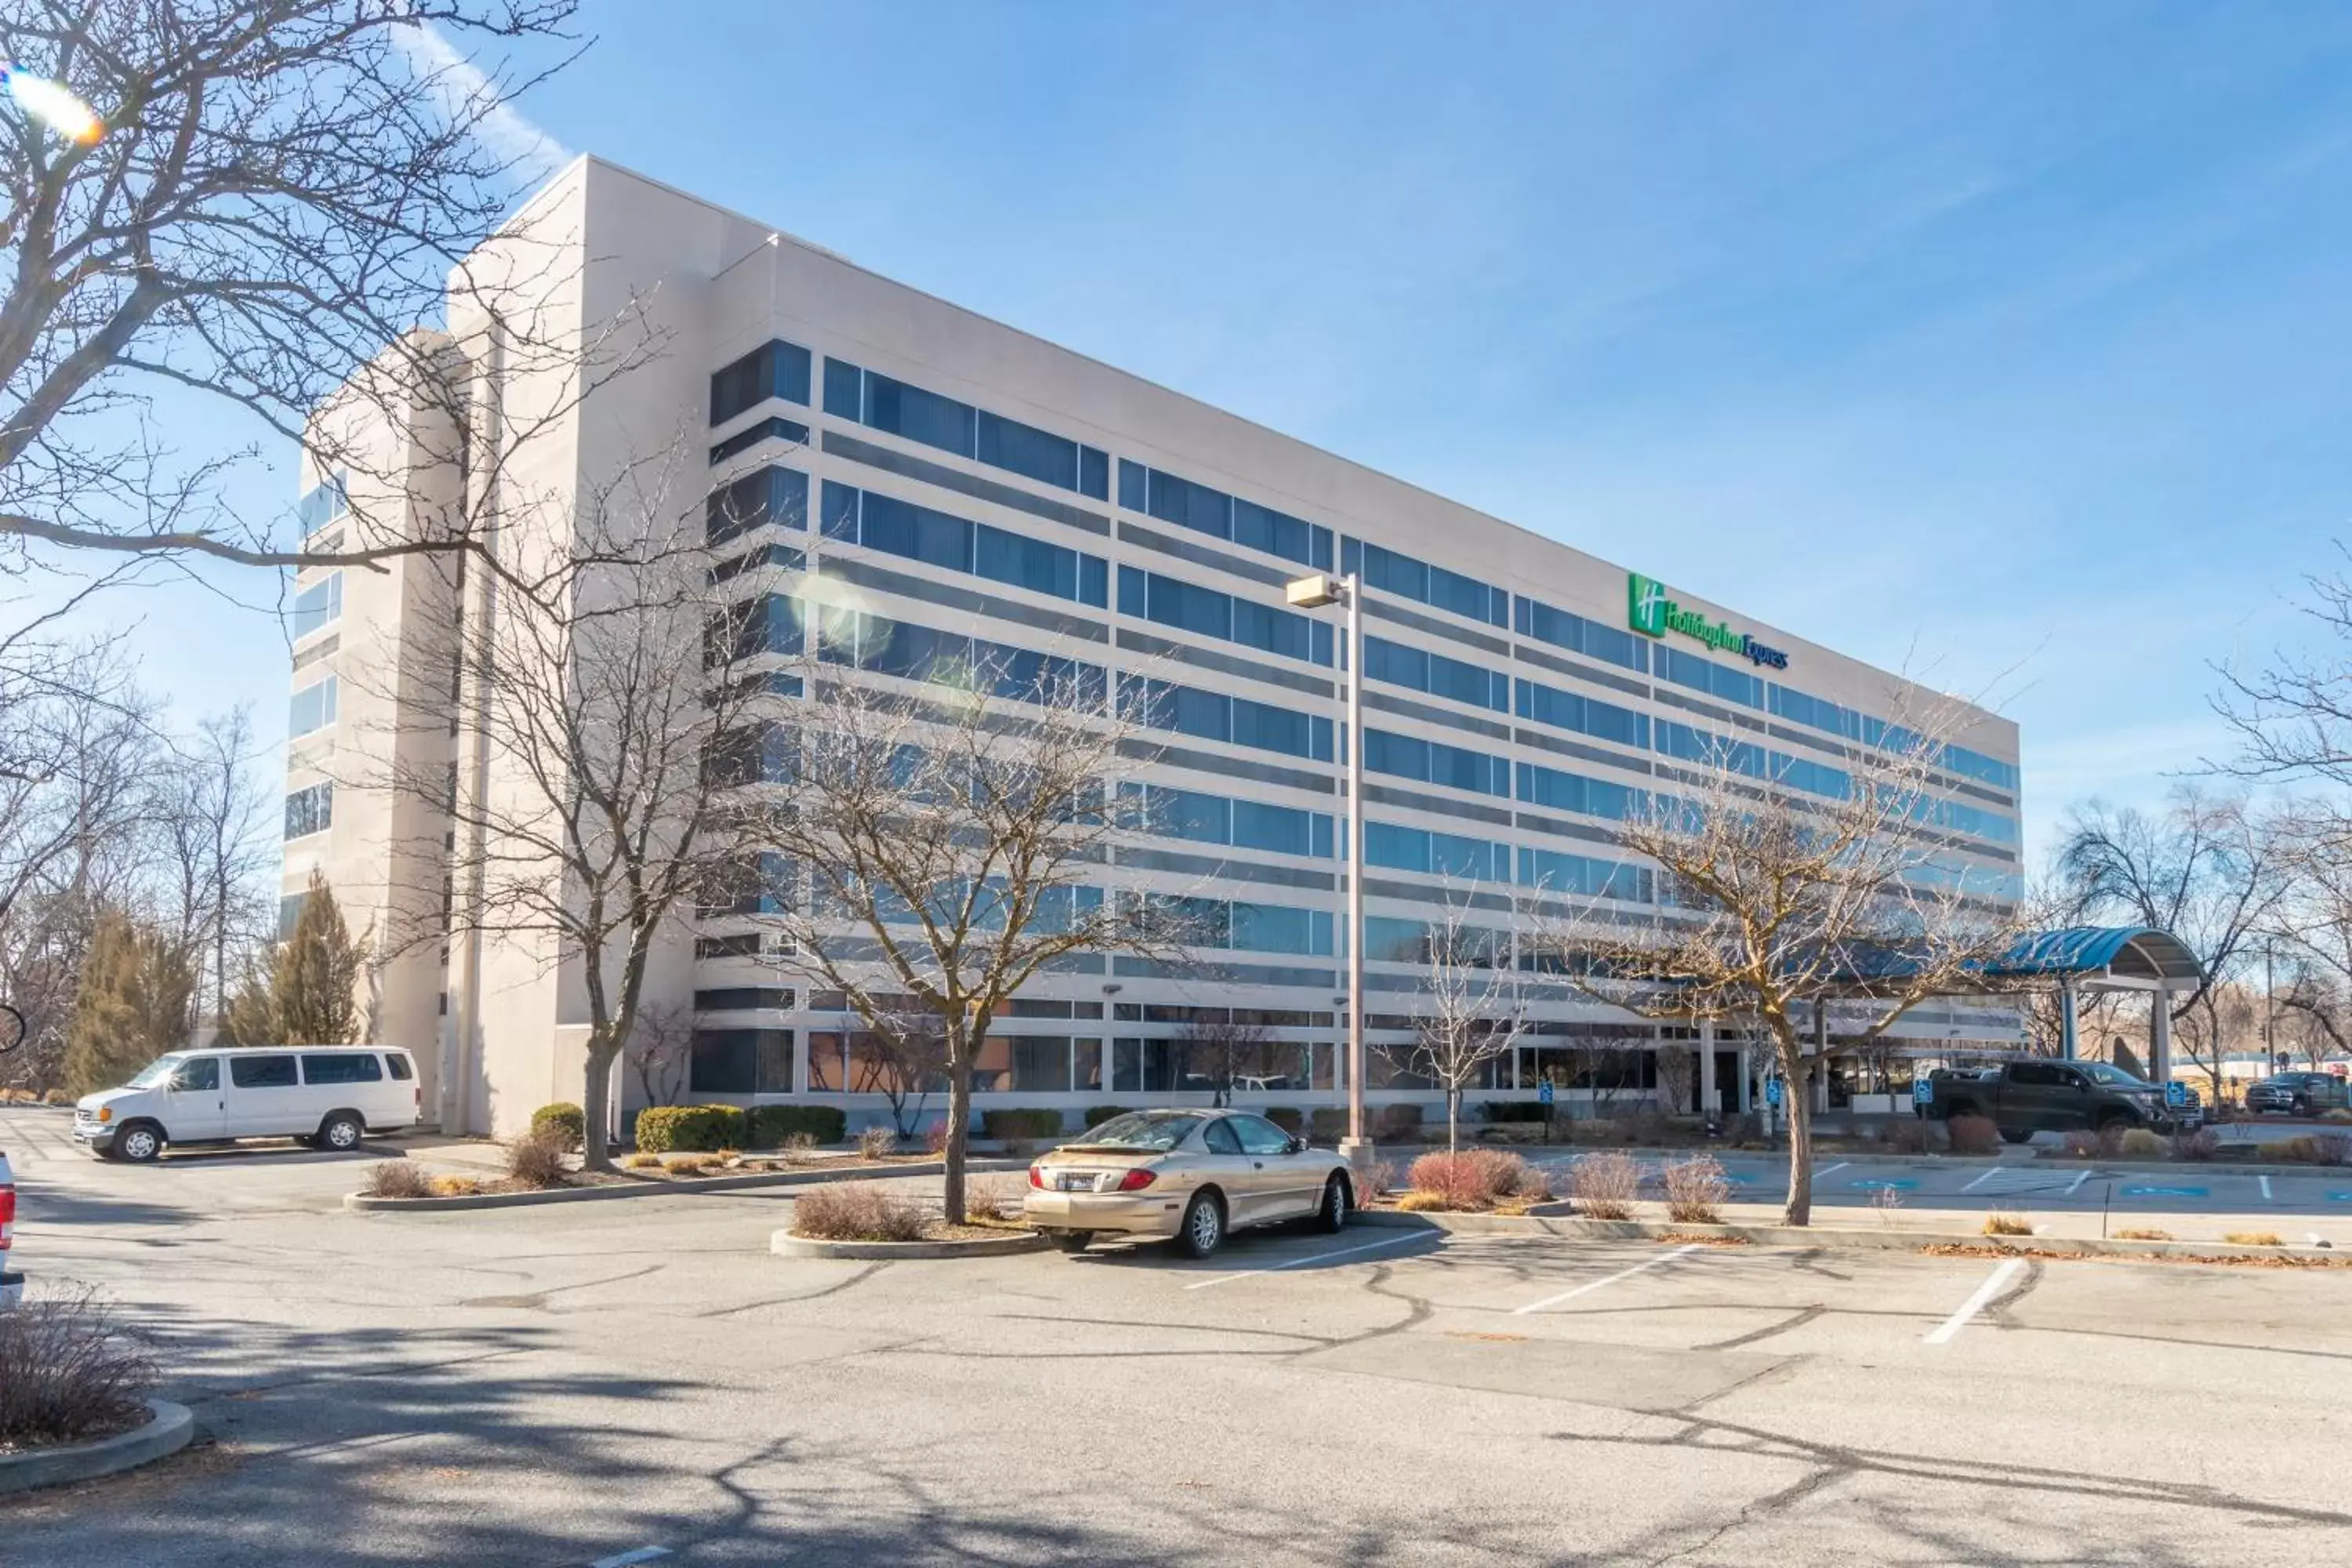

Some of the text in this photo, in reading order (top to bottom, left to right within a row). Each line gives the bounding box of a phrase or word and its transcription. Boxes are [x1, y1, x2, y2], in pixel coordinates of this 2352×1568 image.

[1666, 601, 1788, 670] Holiday Inn Express
